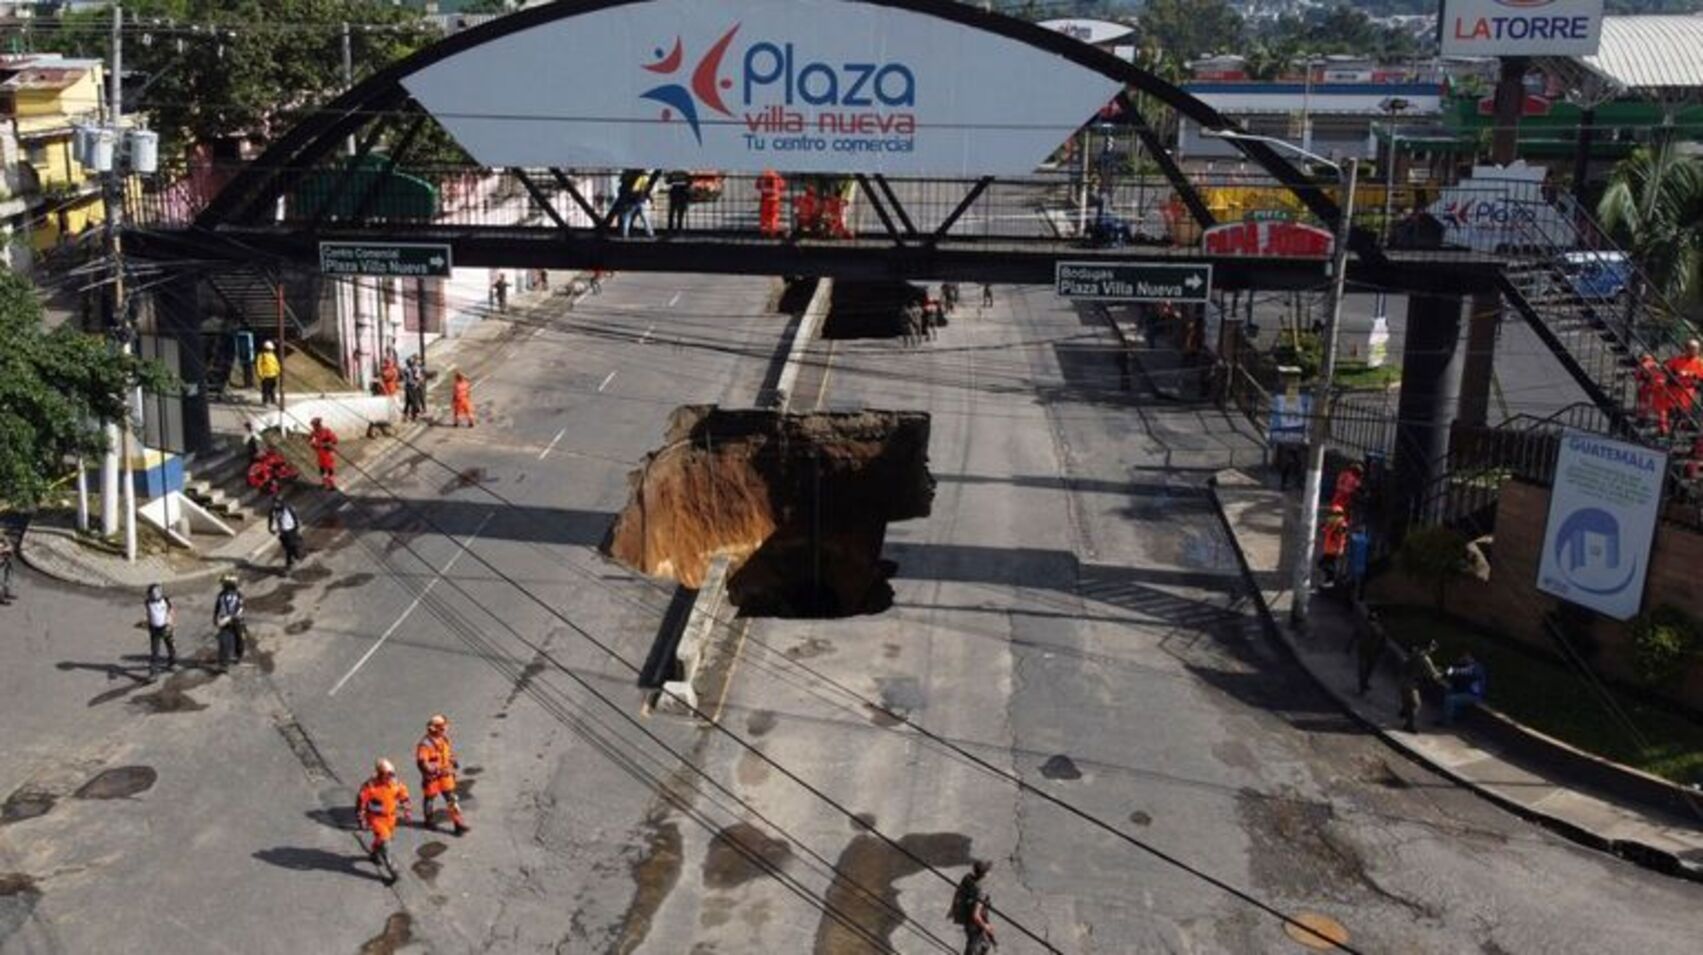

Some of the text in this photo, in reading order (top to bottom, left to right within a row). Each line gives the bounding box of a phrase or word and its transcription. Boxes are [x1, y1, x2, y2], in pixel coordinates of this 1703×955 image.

[743, 42, 916, 106] Plaza
[745, 105, 915, 134] villa nueva
[743, 134, 914, 152] Tu centro comercial
[325, 259, 428, 274] Plaza Villa Nueva
[1061, 281, 1182, 296] Plaza Villa Nueva
[1569, 436, 1655, 472] GUATEMALA
